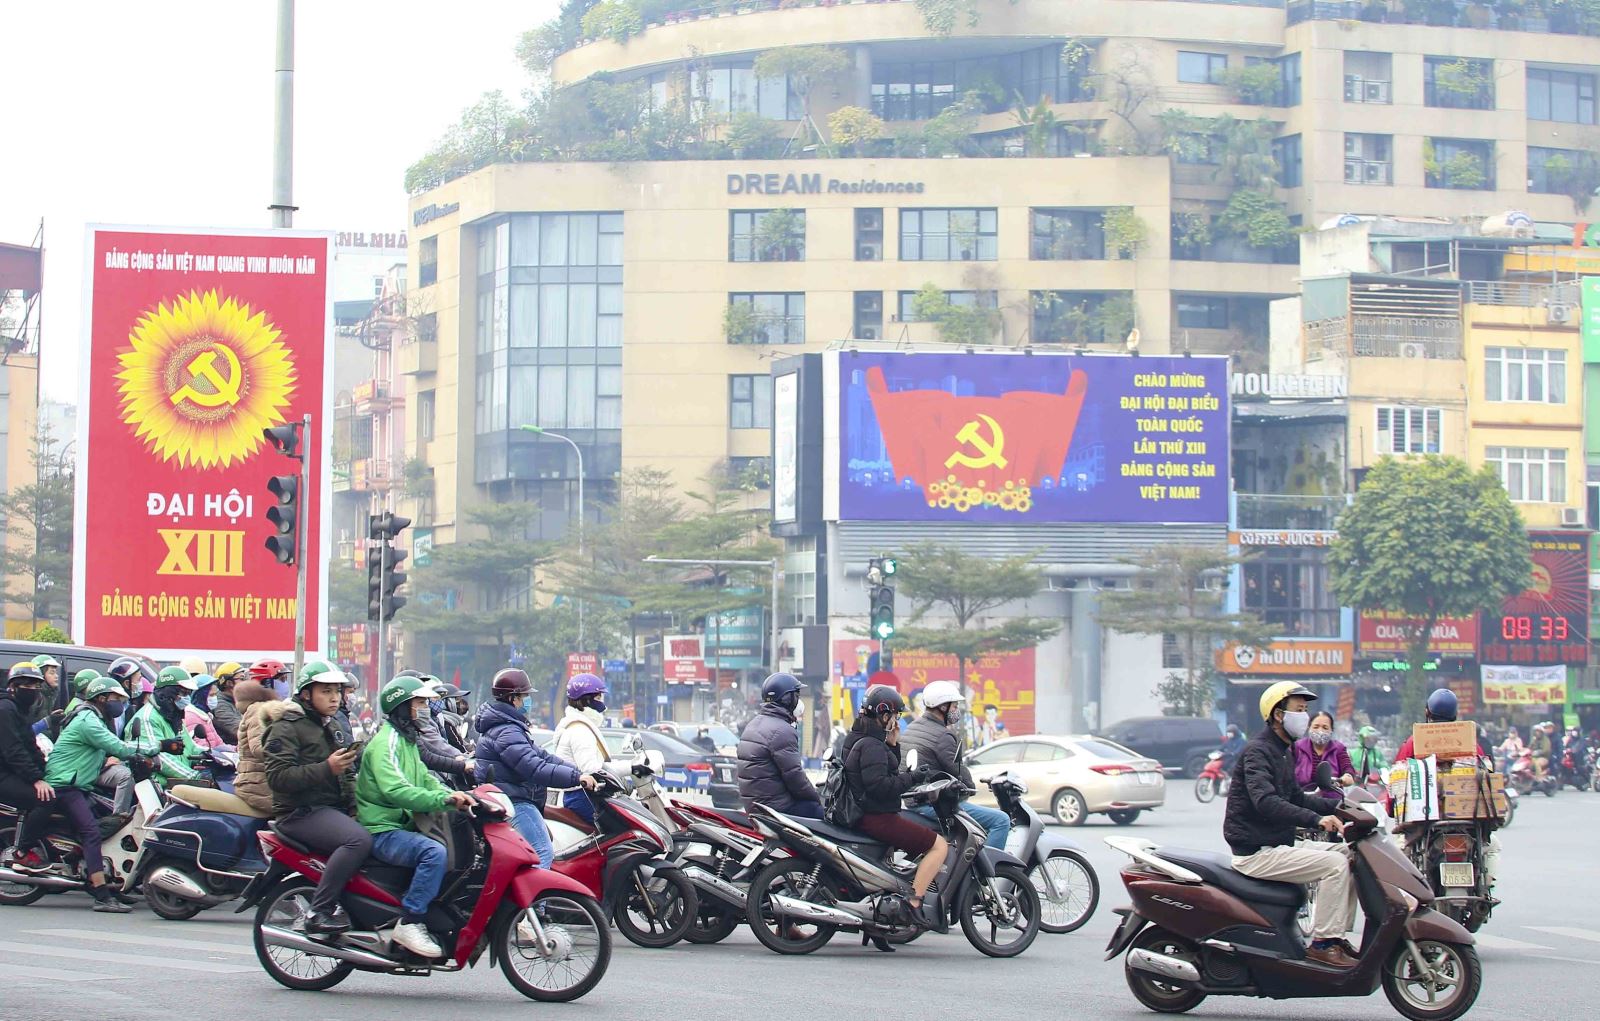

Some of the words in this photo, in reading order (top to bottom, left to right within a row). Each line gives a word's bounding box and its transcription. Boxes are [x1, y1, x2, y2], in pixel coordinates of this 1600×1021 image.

[727, 173, 821, 195] DREAM
[827, 179, 925, 194] Residences
[131, 249, 154, 272] CỘNG
[156, 249, 174, 271] SẢN
[176, 251, 194, 274] VIỆT
[195, 255, 215, 272] NAM
[217, 256, 245, 274] QUANG
[247, 256, 267, 273] VINH
[269, 254, 294, 274] MUÔN
[296, 255, 316, 274] NĂM
[1134, 372, 1167, 388] CHÀO
[1170, 372, 1206, 388] MỪNG
[1120, 396, 1141, 412] ĐẠI
[1144, 394, 1165, 412] HỘI
[1167, 397, 1188, 412] ĐẠI
[1191, 392, 1219, 410] BIỂU
[1136, 416, 1167, 432] TOÀN
[1170, 415, 1204, 433] QUỐC
[1133, 437, 1157, 454] LẦN
[1159, 438, 1184, 454] THỨ
[1185, 441, 1206, 454] XIII
[1120, 460, 1154, 476] ĐẢNG
[1156, 461, 1189, 480] CỘNG
[1192, 460, 1216, 477] SẢN
[1140, 483, 1167, 502] VIỆT
[1169, 486, 1201, 499] NAM!
[146, 492, 194, 523] ĐẠI
[204, 488, 253, 524] HỘI
[156, 529, 246, 576] XIII
[101, 588, 143, 617] ĐẢNG
[148, 591, 190, 622] CỘNG
[194, 590, 225, 619] SẢN
[230, 593, 262, 624] VIỆT
[1502, 616, 1531, 640] 08
[1540, 616, 1568, 640] 33
[160, 674, 174, 682] Grab
[91, 684, 106, 693] Grab
[387, 688, 405, 703] Grab
